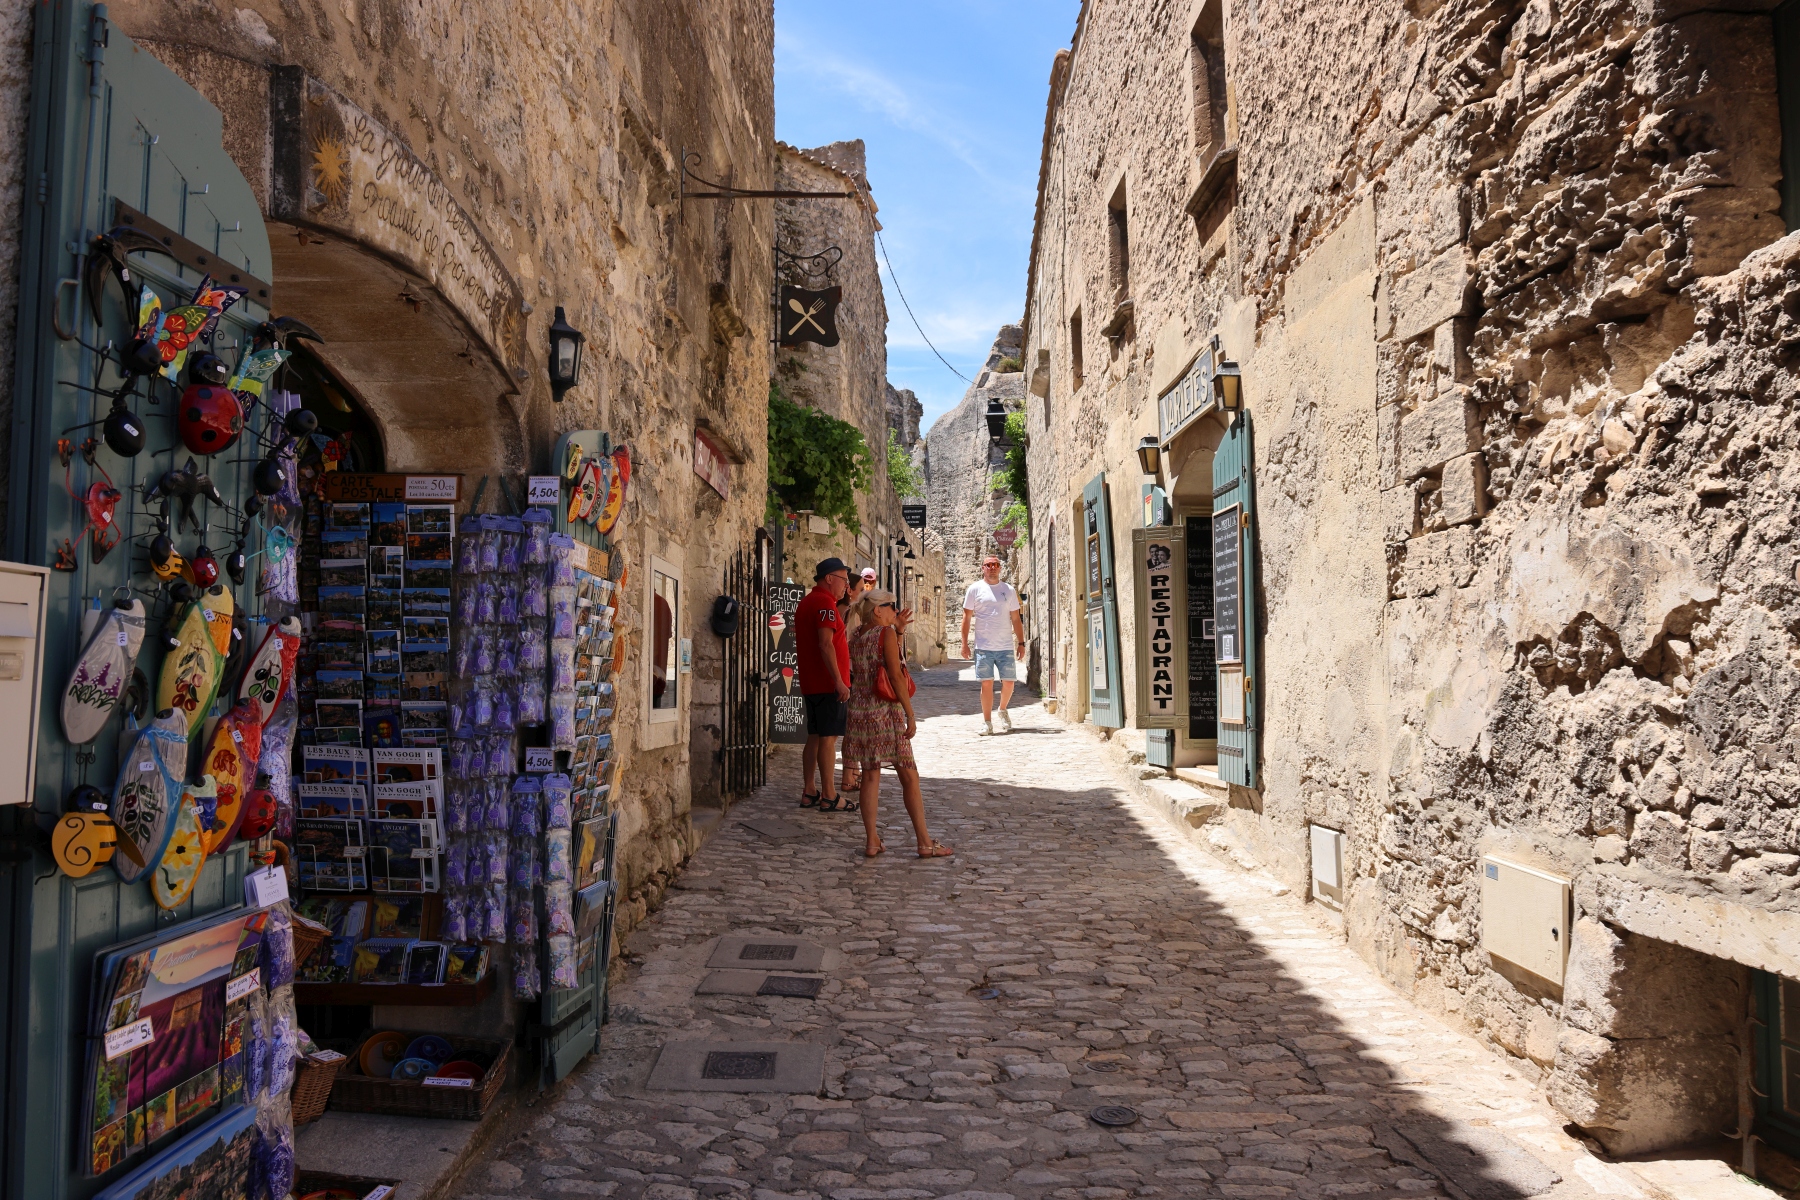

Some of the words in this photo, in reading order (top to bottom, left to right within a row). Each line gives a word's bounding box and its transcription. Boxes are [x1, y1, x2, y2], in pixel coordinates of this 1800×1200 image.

[331, 476, 374, 487] CARTE
[341, 488, 402, 498] POSTALE
[529, 486, 559, 499] 4,50€
[770, 586, 803, 602] GLACE
[819, 609, 836, 623] 76
[1150, 574, 1174, 709] RESTAURANT
[774, 713, 804, 725] BOISSON
[307, 746, 324, 754] LES
[527, 756, 554, 768] 4,50€
